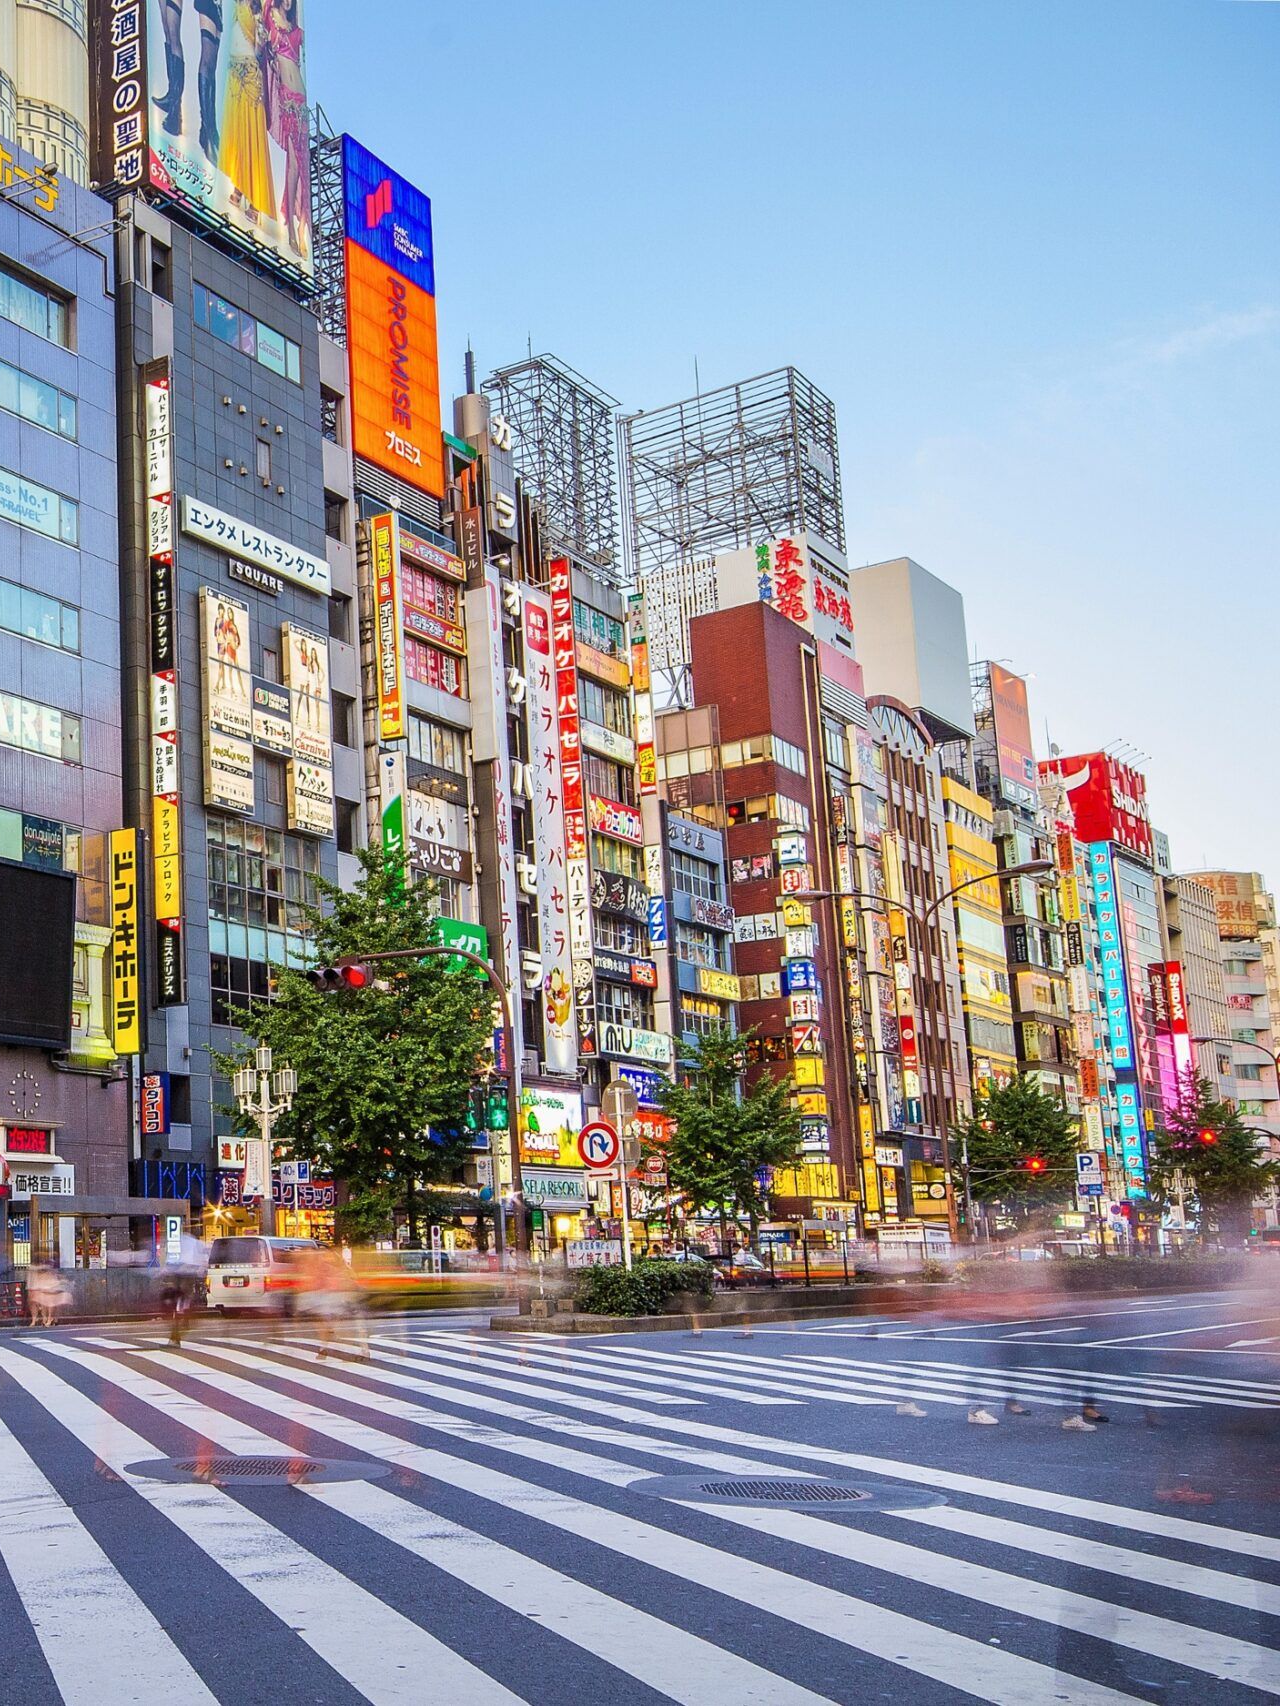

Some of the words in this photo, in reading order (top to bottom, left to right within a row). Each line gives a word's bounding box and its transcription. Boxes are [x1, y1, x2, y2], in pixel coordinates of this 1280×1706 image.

[110, 0, 144, 185] 酒屋の聖地
[393, 222, 409, 239] SMBC
[393, 231, 424, 260] CONSUMER
[393, 239, 419, 263] FINANCE
[387, 275, 413, 431] PROMISE
[157, 393, 168, 459] バドワイザー
[148, 427, 159, 482] カーニバル
[384, 430, 424, 468] プロミス
[0, 497, 41, 523] TRAVEL
[465, 518, 478, 570] 水上ビル
[235, 560, 284, 593] SQUARE
[550, 574, 581, 788] カラオケパセラ
[158, 684, 169, 727] 手羽一郎
[295, 738, 330, 759] Carnival
[155, 746, 165, 794] ひとめぼれ
[1111, 787, 1150, 824] SHIDAX
[161, 808, 172, 902] アラビアンロック
[386, 828, 401, 868] レイ
[571, 865, 584, 937] パーティー
[651, 898, 663, 940] 747
[164, 937, 175, 996] ミステリアス
[1169, 973, 1186, 1021] SHIDAX
[145, 1075, 160, 1087] 薬
[145, 1088, 160, 1133] ダイコク
[221, 1142, 245, 1161] 進化
[1089, 1115, 1100, 1148] RIRAKU
[1079, 1155, 1093, 1172] P
[222, 1177, 239, 1203] 薬
[169, 1219, 178, 1238] P
